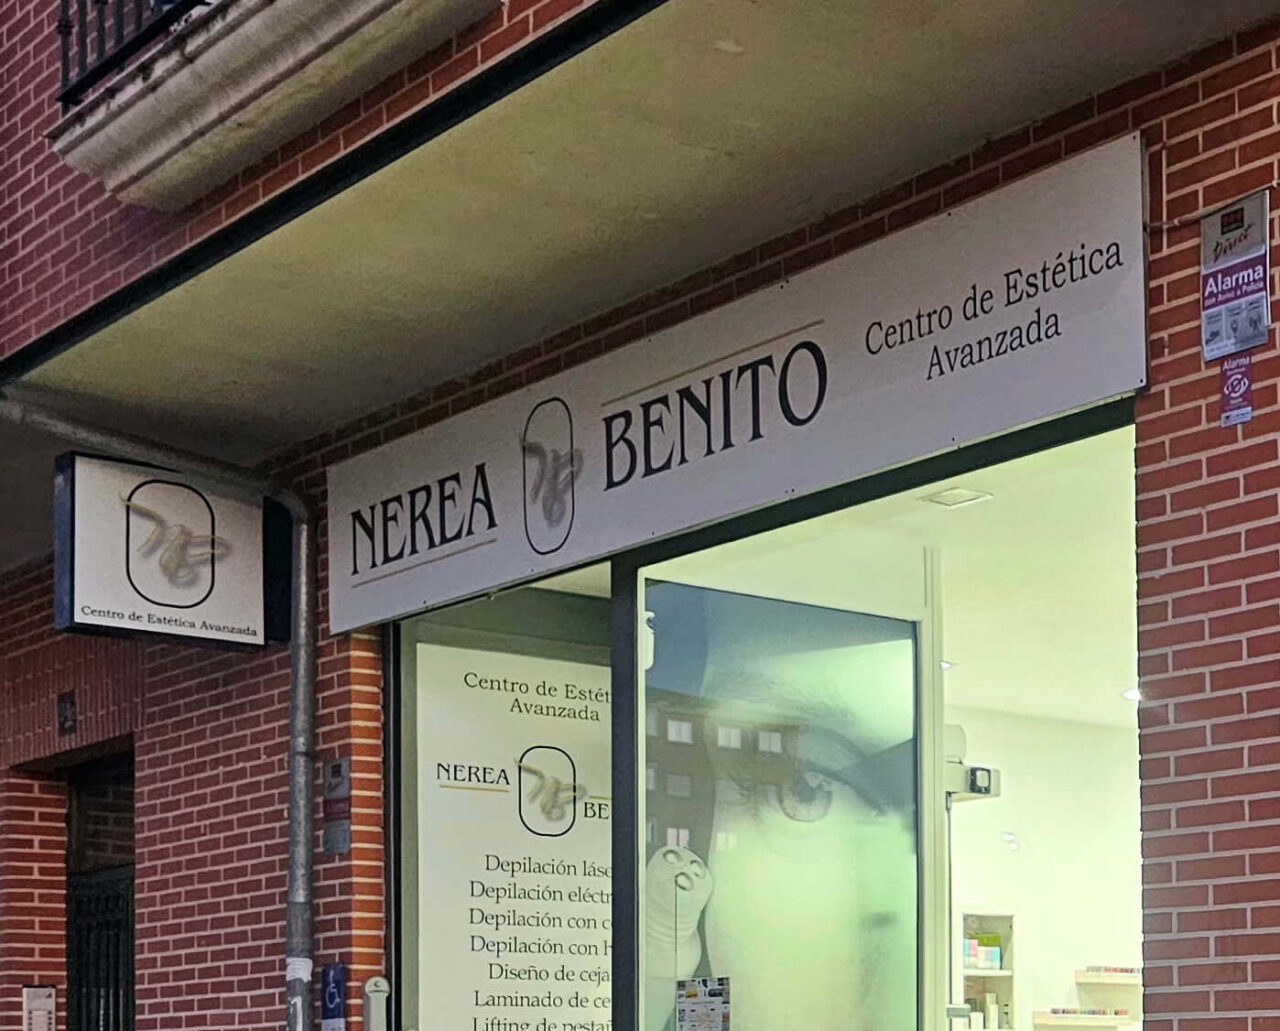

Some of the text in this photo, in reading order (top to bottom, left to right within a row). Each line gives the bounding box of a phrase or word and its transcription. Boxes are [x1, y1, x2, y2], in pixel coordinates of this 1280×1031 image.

[1204, 265, 1264, 297] Alarma
[864, 240, 1124, 357] Centro de Estética
[925, 309, 1062, 381] Avanzada
[1222, 356, 1250, 372] Alarma
[351, 339, 829, 577] NEREA BENITO
[81, 605, 258, 637] Centro de Estética Avanzada
[463, 671, 530, 694] Centro
[535, 681, 558, 699] de
[509, 697, 600, 722] Avanzada
[436, 762, 610, 820] NEREA BE
[485, 853, 577, 878] Depilación
[469, 880, 563, 904] Depilación
[469, 907, 562, 932] Depilación
[567, 917, 598, 930] con
[470, 935, 563, 958] Depilación
[568, 943, 599, 956] con
[488, 962, 610, 988] Diseño de ceja
[474, 990, 611, 1009] Laminado de ce
